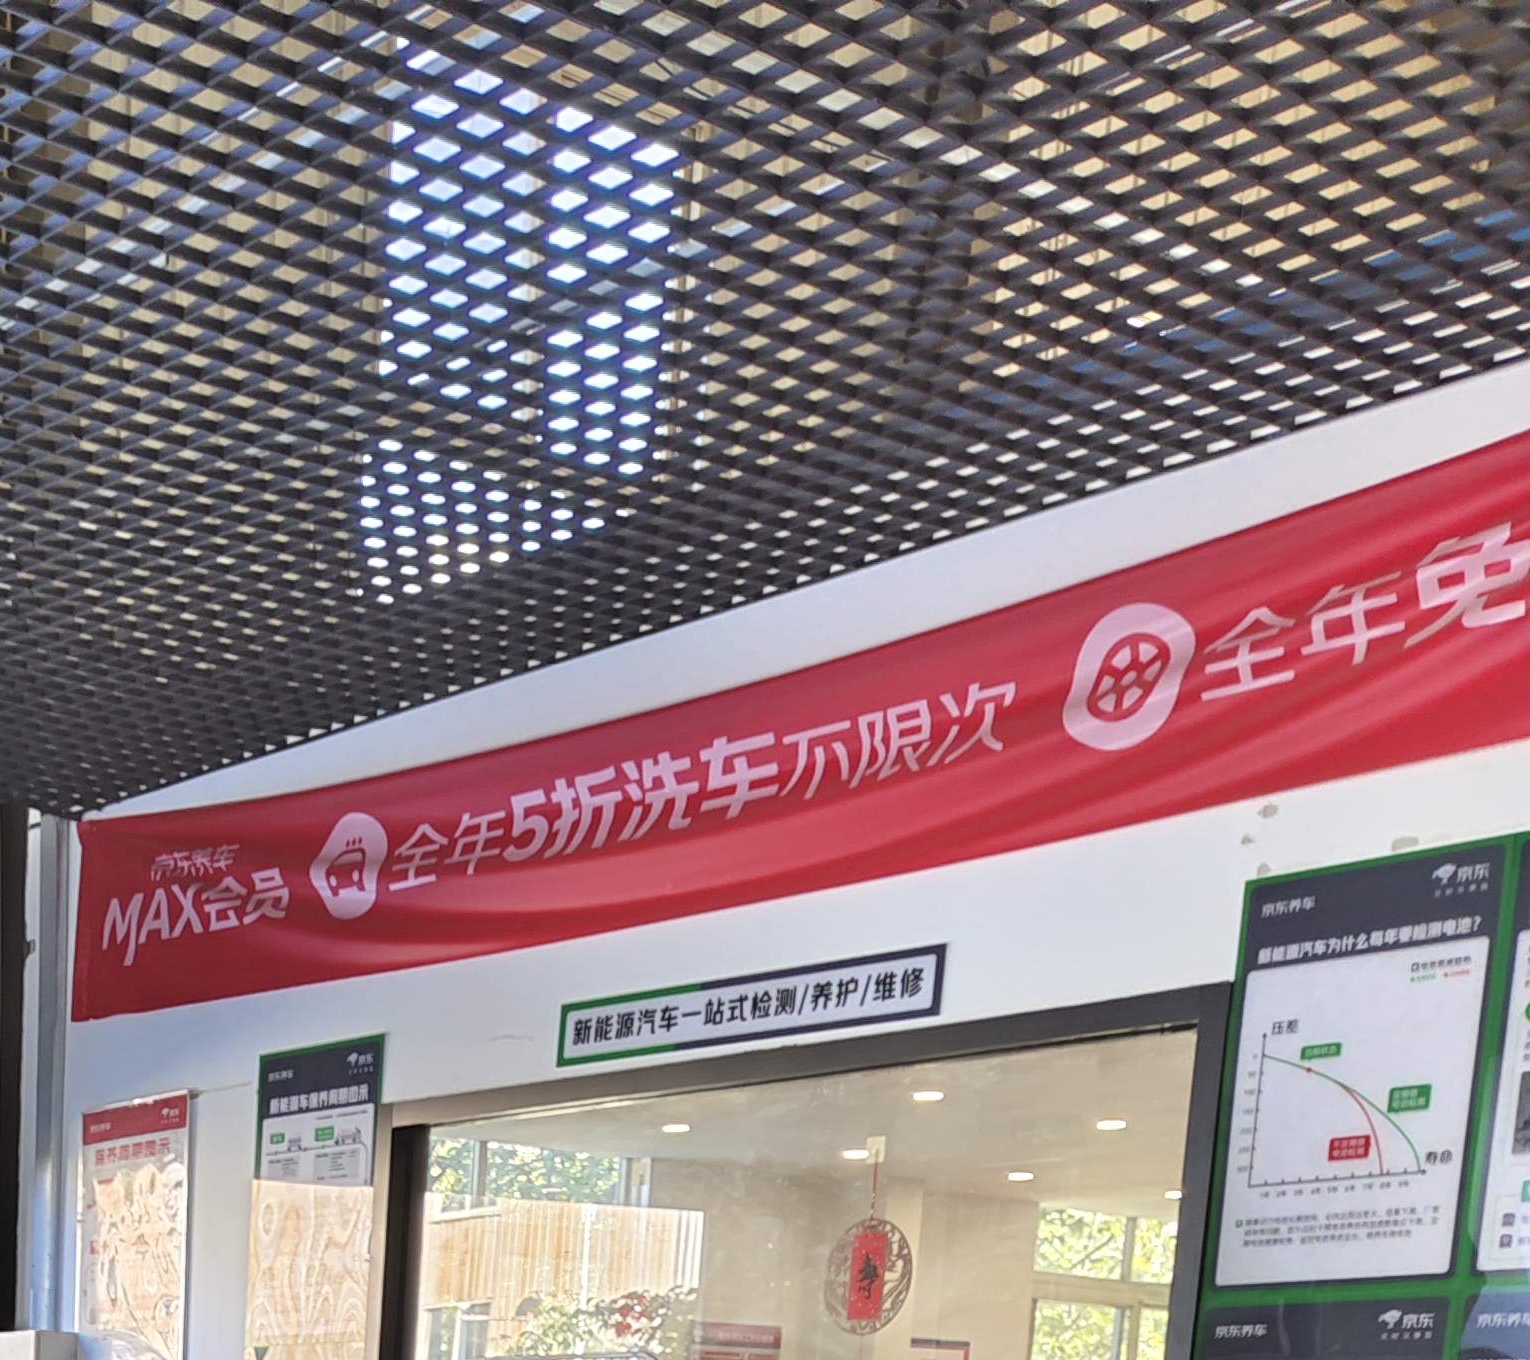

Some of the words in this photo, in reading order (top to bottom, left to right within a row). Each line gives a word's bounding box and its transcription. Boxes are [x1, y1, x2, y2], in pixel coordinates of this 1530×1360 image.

[388, 680, 1017, 893] 全年5折洗车不限次
[150, 843, 240, 882] 京东养车
[101, 866, 291, 966] MAX会员
[1261, 896, 1316, 918] 京东养车
[573, 966, 926, 1046] 新能源汽车一站式检测/养护/维修
[1214, 1323, 1268, 1340] 京东养车
[1402, 1312, 1435, 1329] 京东
